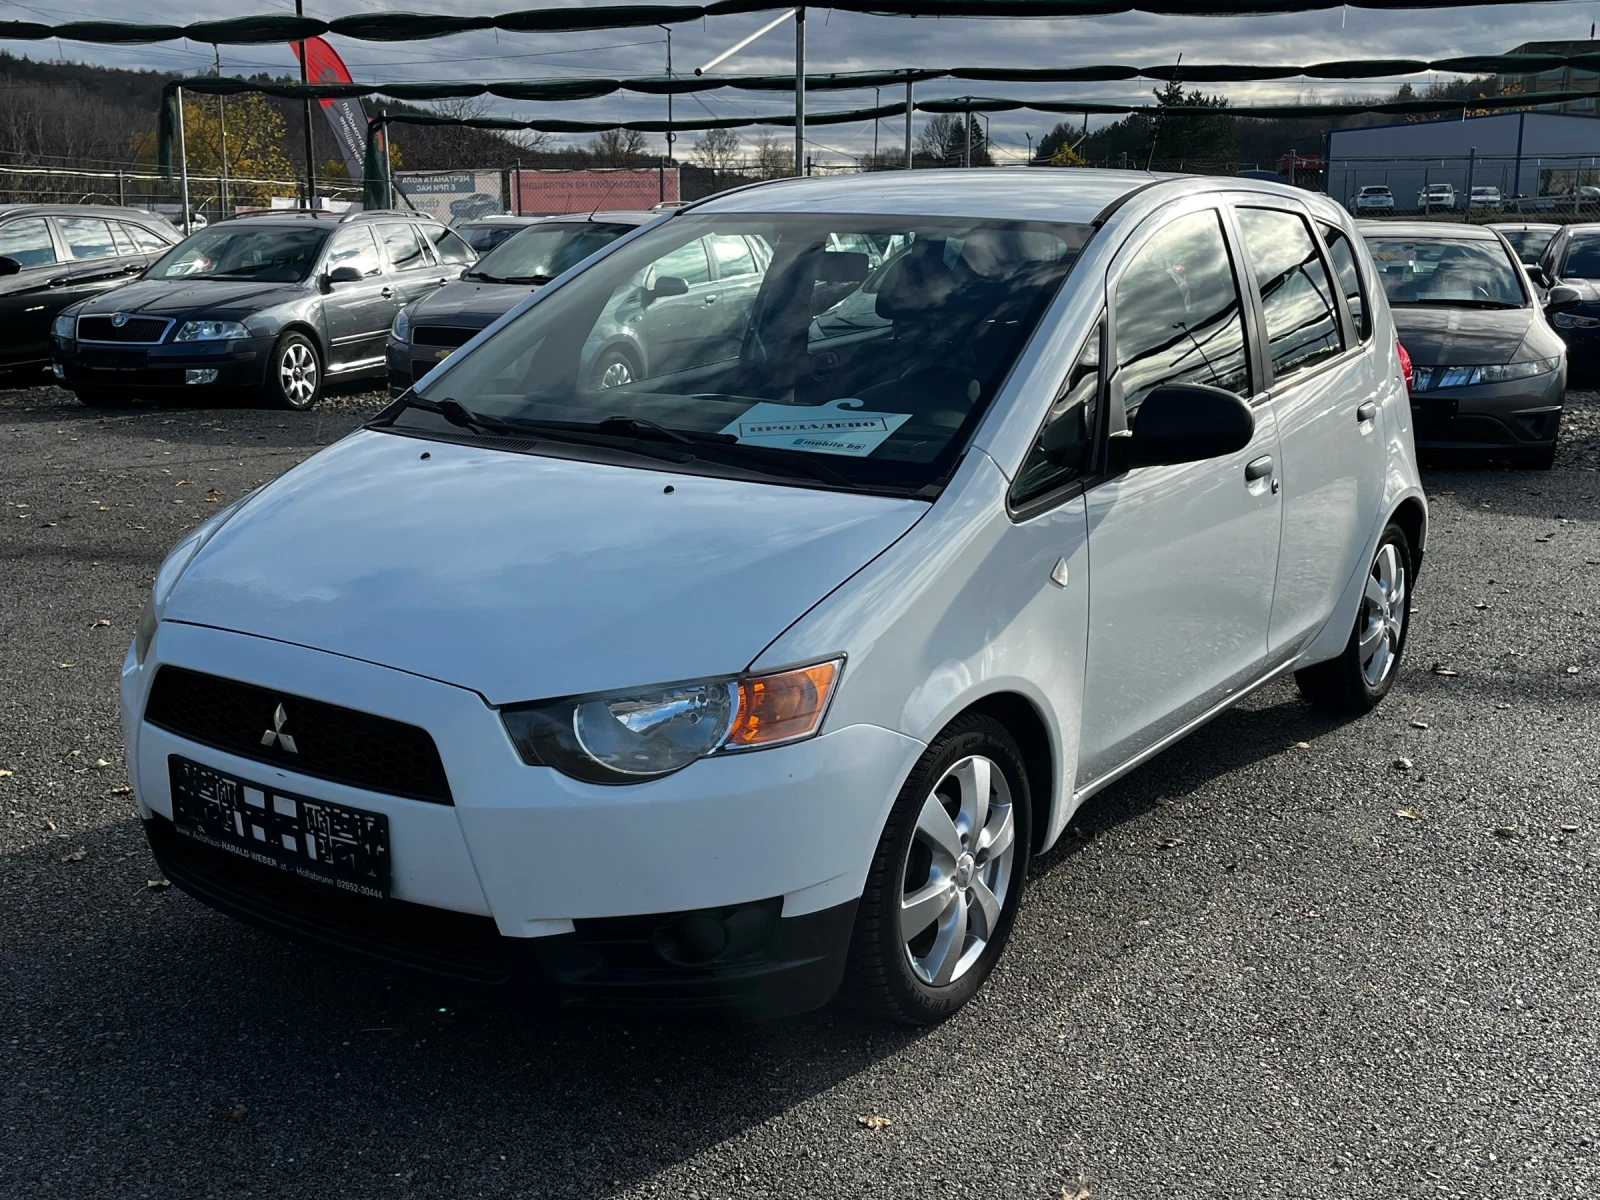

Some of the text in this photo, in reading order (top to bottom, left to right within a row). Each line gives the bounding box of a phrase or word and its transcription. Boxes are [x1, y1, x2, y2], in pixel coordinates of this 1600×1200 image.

[750, 421, 876, 432] ПРОДАДЕНО
[803, 439, 862, 450] mobile.bg
[296, 866, 333, 886] Hollabrunn
[336, 879, 383, 899] 02952-30444
